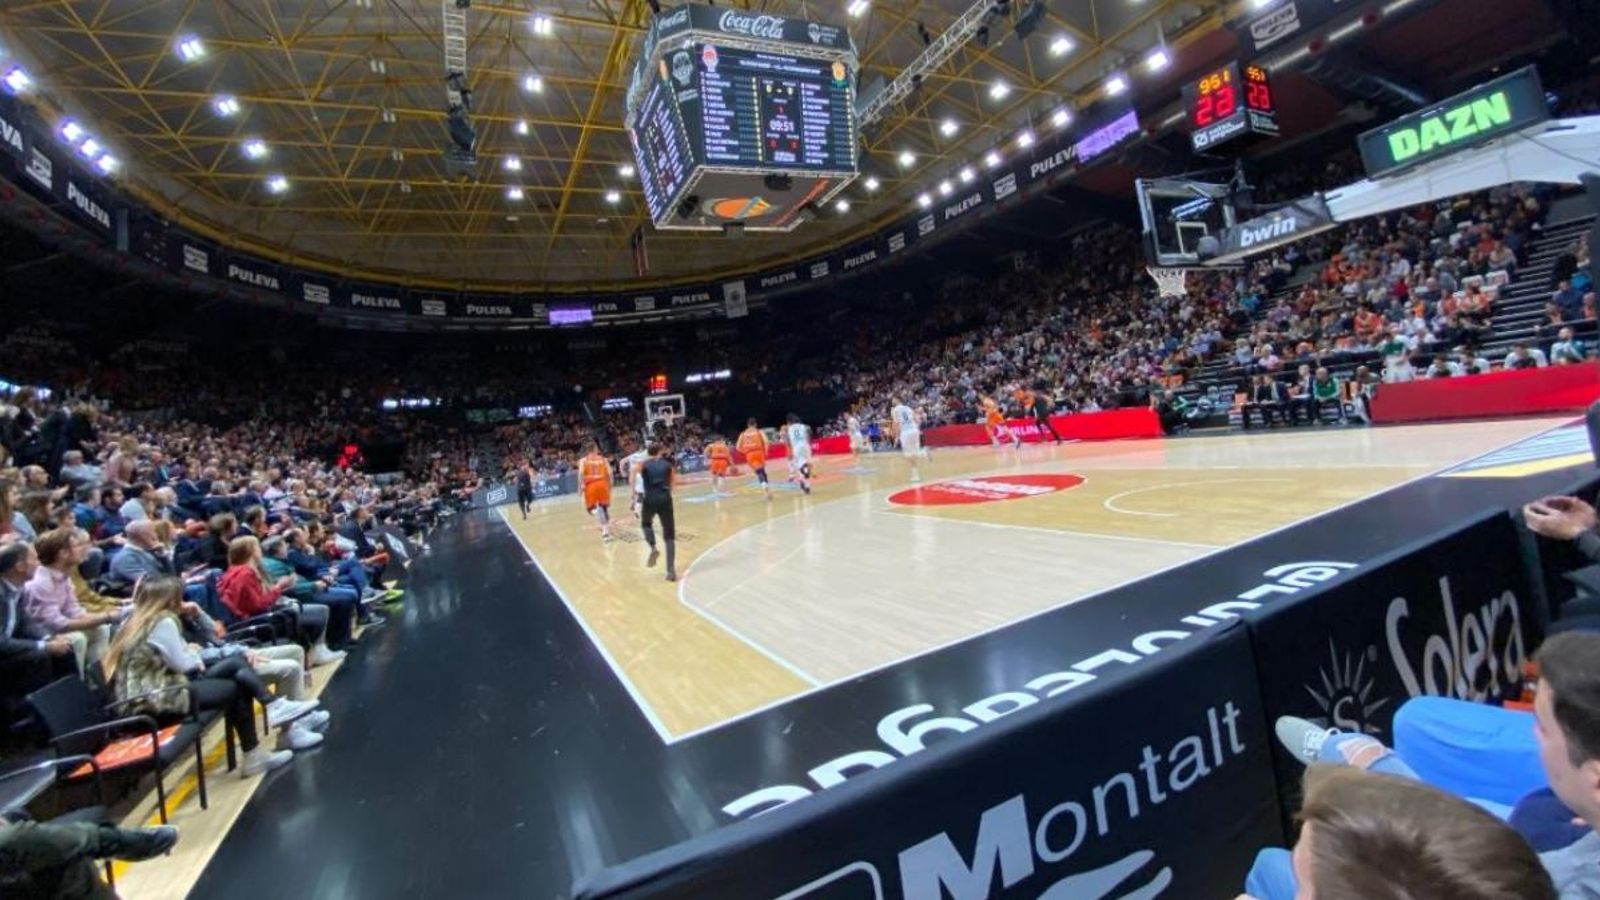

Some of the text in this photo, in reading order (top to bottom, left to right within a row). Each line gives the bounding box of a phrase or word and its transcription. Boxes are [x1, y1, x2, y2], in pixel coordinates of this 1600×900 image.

[1388, 92, 1511, 162] DAZN
[67, 180, 110, 228] PULEVA
[945, 192, 982, 220] PULEVA
[1241, 217, 1296, 247] bwin
[844, 250, 877, 270] PULEVA
[228, 264, 280, 290] PULEVA
[351, 293, 402, 308] PULEVA
[466, 303, 513, 316] PULEVA
[1385, 576, 1527, 703] Solera
[898, 700, 1246, 900] Montalt
